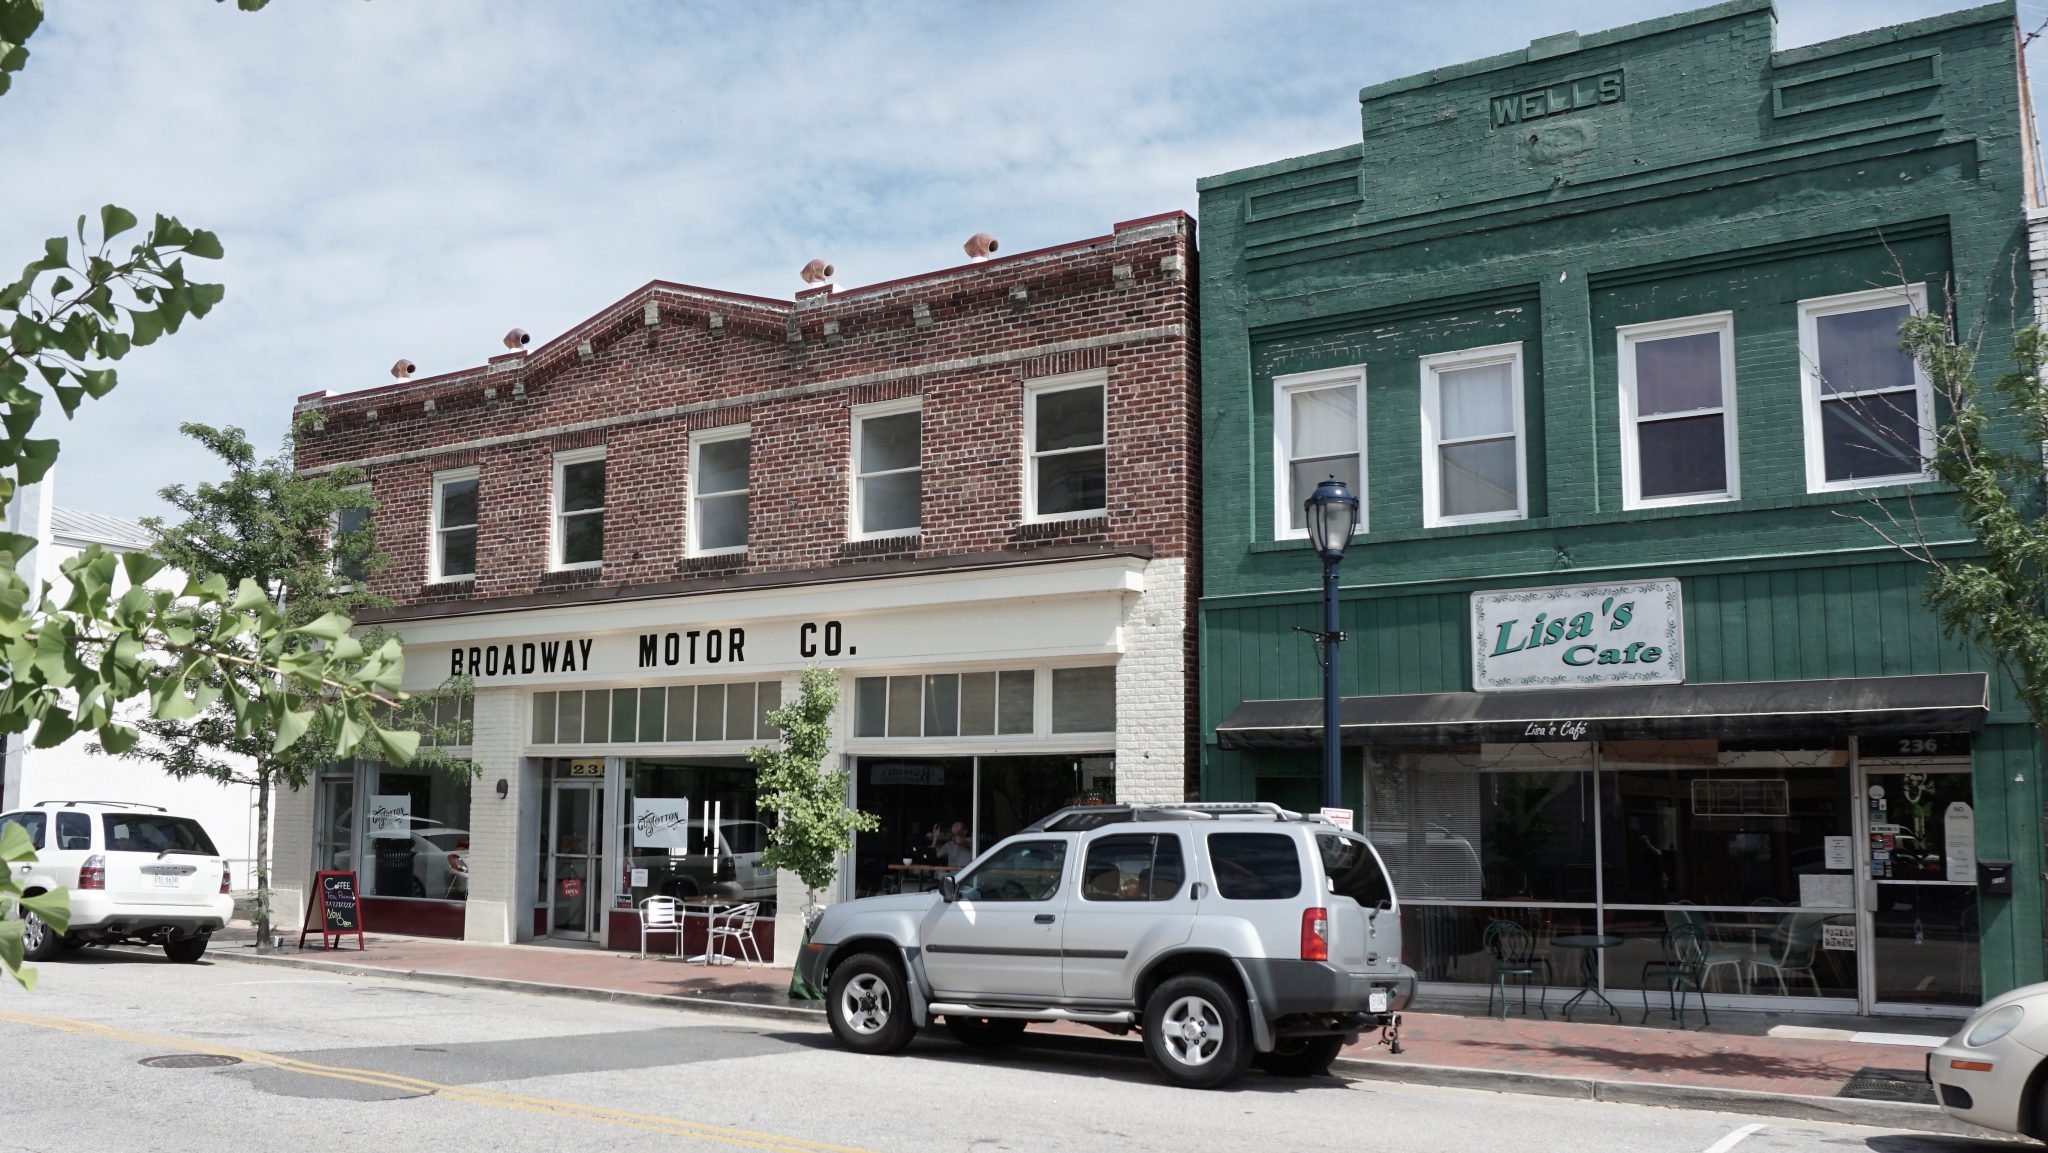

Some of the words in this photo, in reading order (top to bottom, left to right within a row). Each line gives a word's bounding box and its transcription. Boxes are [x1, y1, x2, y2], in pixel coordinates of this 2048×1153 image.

[1493, 74, 1621, 125] WELLS
[1488, 596, 1635, 658] Lisa's
[450, 638, 593, 677] BROADWAY
[639, 627, 745, 667] MOTOR
[800, 620, 857, 658] CO.
[1562, 641, 1663, 667] Cafe
[1524, 721, 1556, 737] Lisa's
[1898, 739, 1938, 753] 236
[573, 764, 605, 775] 23
